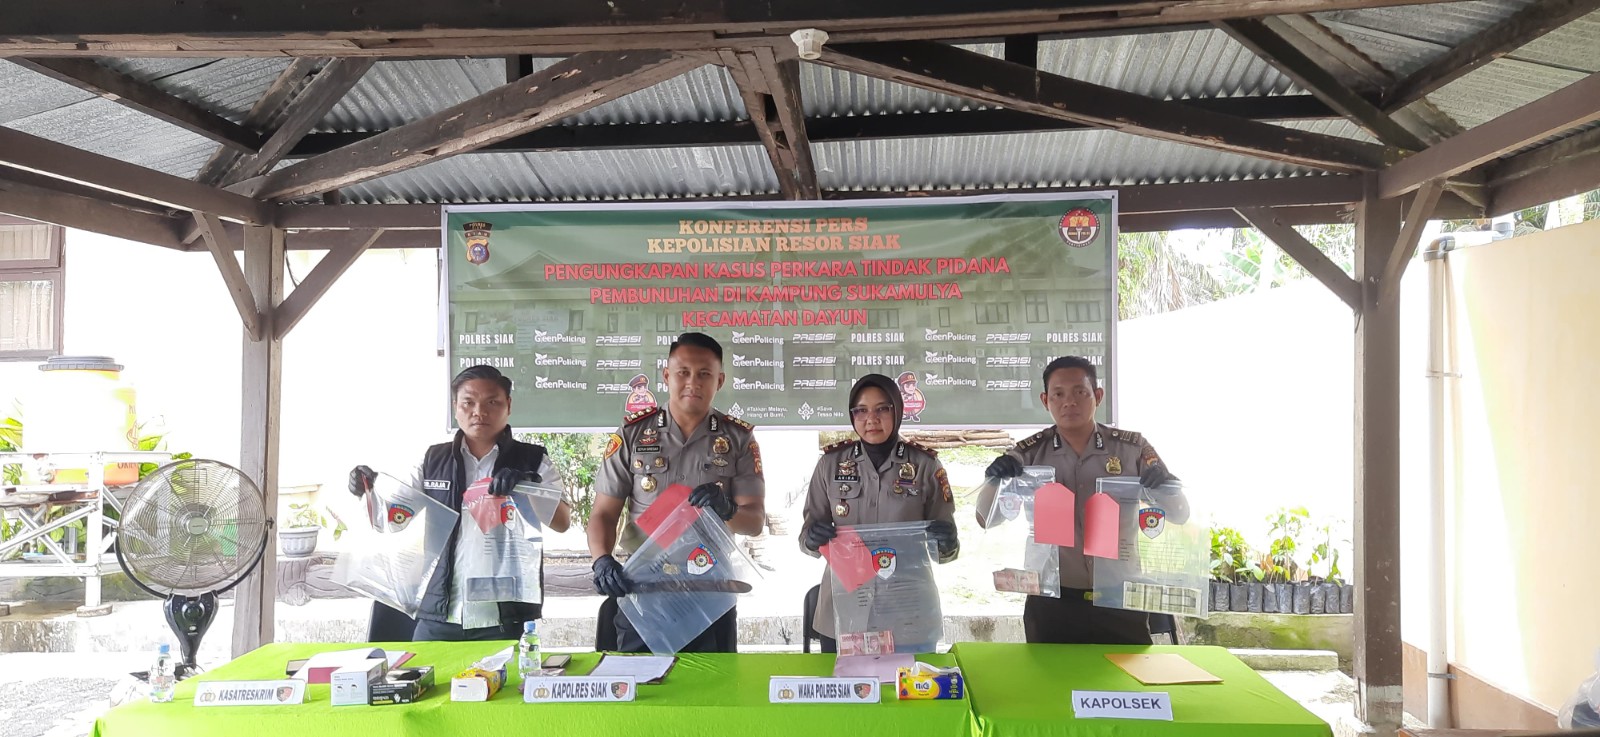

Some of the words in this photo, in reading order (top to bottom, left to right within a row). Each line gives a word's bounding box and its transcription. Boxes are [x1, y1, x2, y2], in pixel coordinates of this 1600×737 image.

[680, 219, 810, 234] KONFERENSI
[816, 217, 867, 234] PERS
[648, 237, 770, 253] KEPOLISIAN
[776, 235, 844, 251] RESOR
[849, 235, 900, 250] SIAK
[545, 263, 698, 280] PENGUNGKAPAN
[704, 262, 766, 278] KASUS
[771, 261, 857, 277] PERKARA
[861, 258, 932, 276] TINDAK
[936, 257, 1009, 275] PIDANA
[591, 287, 718, 303] PEMBUNUHAN
[724, 287, 741, 302] DI
[746, 285, 843, 302] KAMPUNG
[847, 283, 962, 300] SUKAMULYA
[683, 310, 797, 326] KECAMATAN
[803, 309, 867, 325] DAYUN
[460, 334, 490, 345] POLRES
[494, 334, 514, 345] SIAK
[596, 336, 642, 344] PRESISI
[656, 336, 678, 346] POLR
[793, 333, 836, 342] PRESISI
[852, 332, 882, 343] POLRES
[886, 332, 905, 343] SIAK
[986, 333, 1032, 342] PRESISI
[1046, 332, 1078, 343] POLRES
[1082, 332, 1102, 343] SIAK
[460, 358, 492, 368] POLRES
[494, 358, 514, 368] SIAK
[596, 360, 642, 368] PRESISI
[793, 356, 836, 366] PRESISI
[852, 356, 882, 366] POLRES
[886, 356, 905, 366] SIAK
[986, 357, 1032, 366] PRESISI
[794, 380, 836, 388] PRESISI
[986, 380, 1032, 389] PRESISI
[219, 689, 274, 700] KASATRESKRIM
[552, 682, 588, 698] KAPOLRES
[590, 682, 607, 698] SIAK
[798, 684, 814, 698] WAKA
[816, 684, 837, 698] POLRES
[838, 684, 851, 698] SIAK
[1080, 696, 1162, 710] KAPOLSEK
